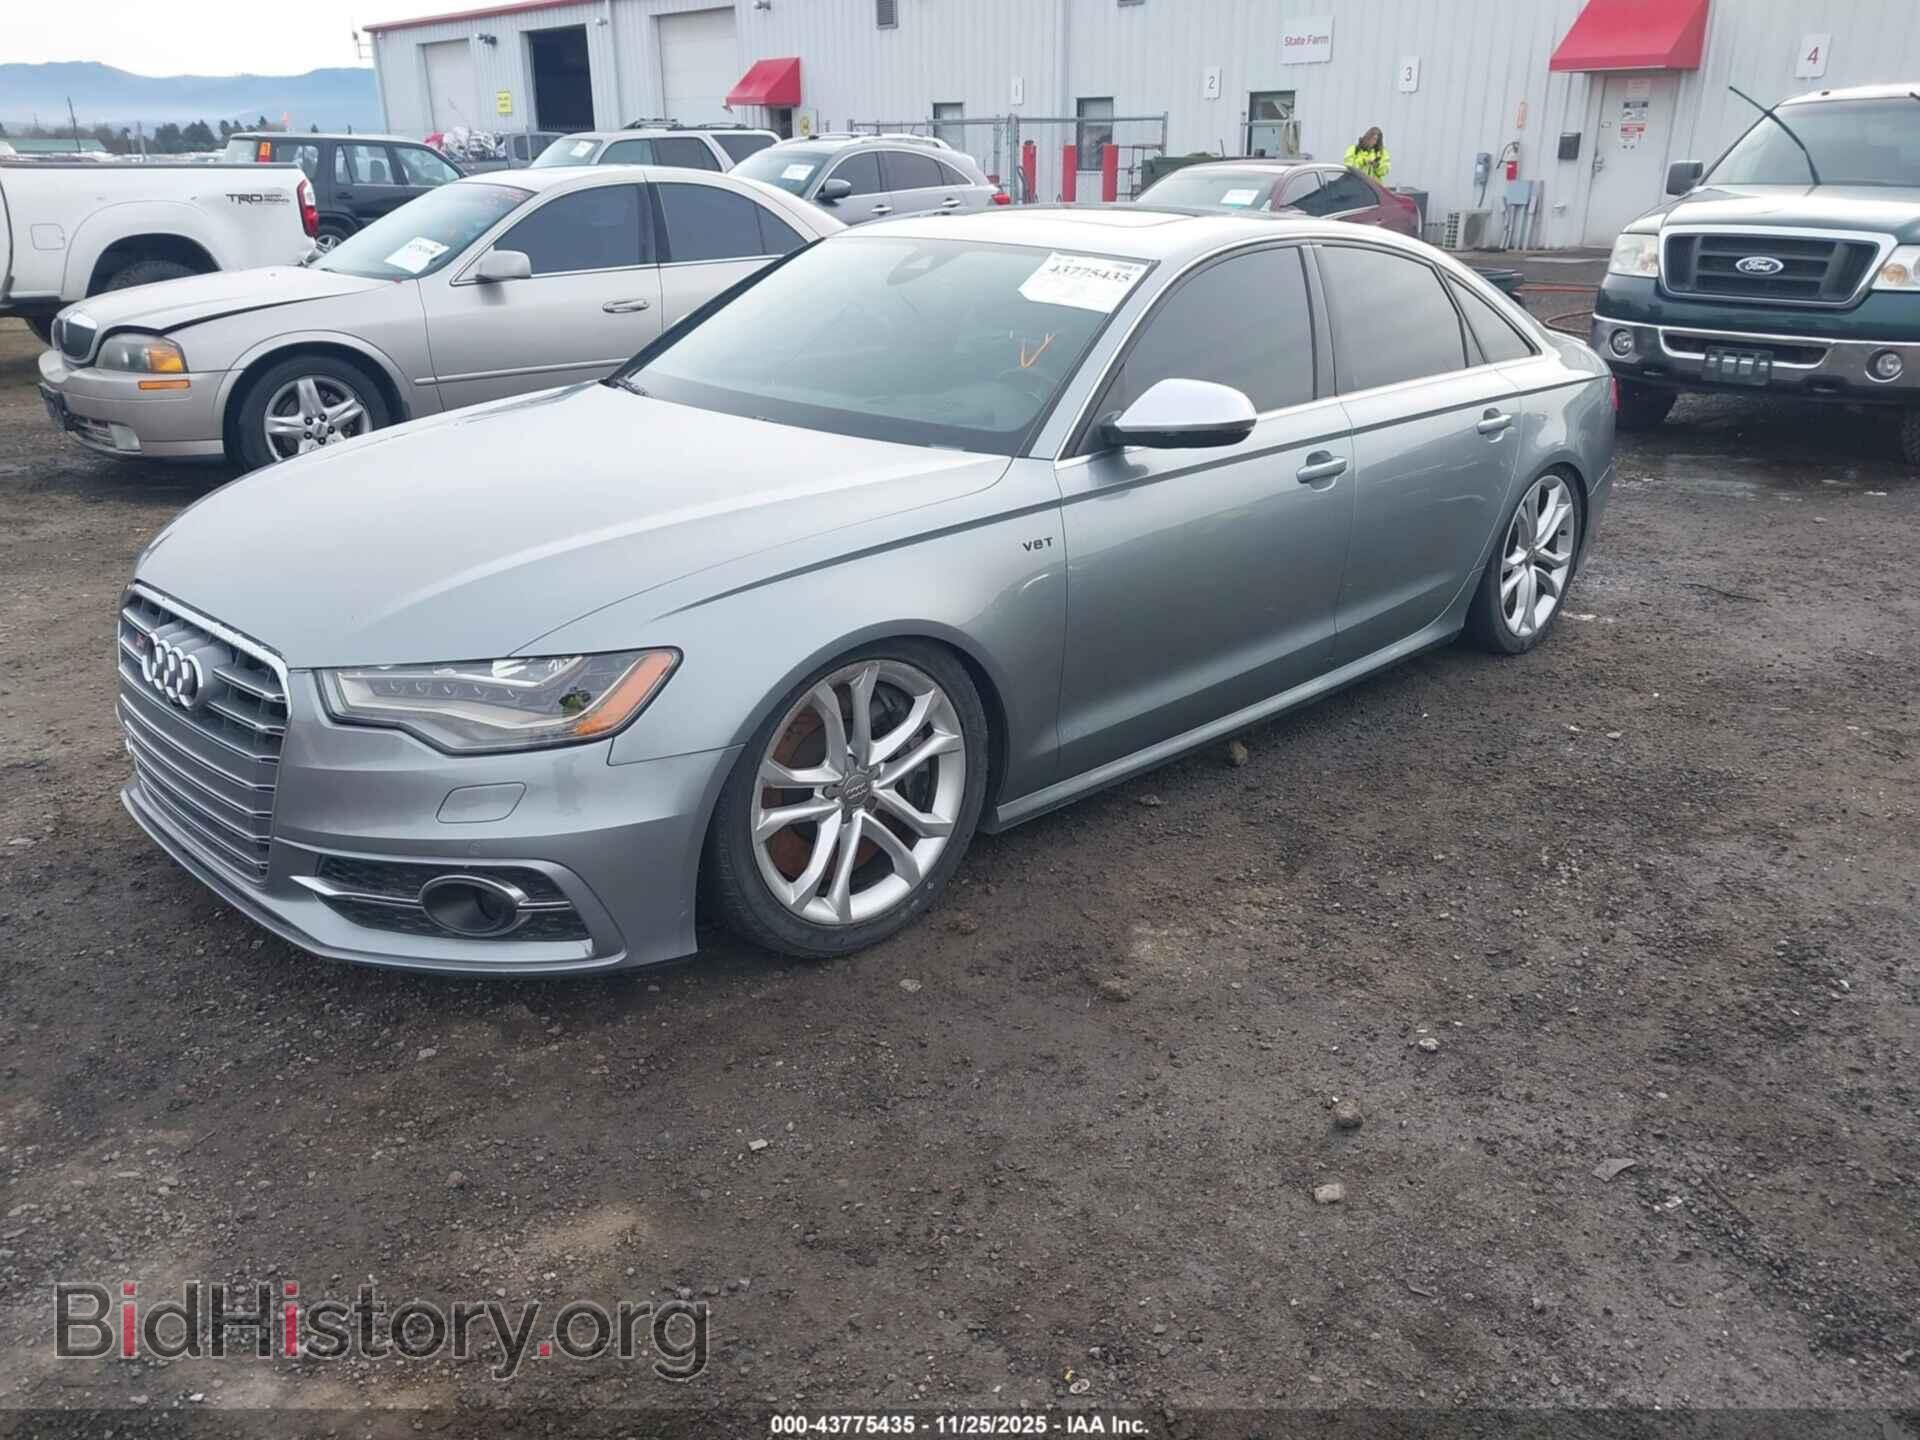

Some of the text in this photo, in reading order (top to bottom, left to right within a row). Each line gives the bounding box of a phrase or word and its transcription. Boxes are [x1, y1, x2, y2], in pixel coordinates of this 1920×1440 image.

[1283, 34, 1329, 47] State Farm
[1807, 46, 1819, 64] 4
[1405, 66, 1413, 82] 3
[1207, 75, 1216, 90] 2
[225, 193, 264, 205] TRD
[1744, 260, 1773, 271] Ford
[1021, 536, 1054, 552] V8T
